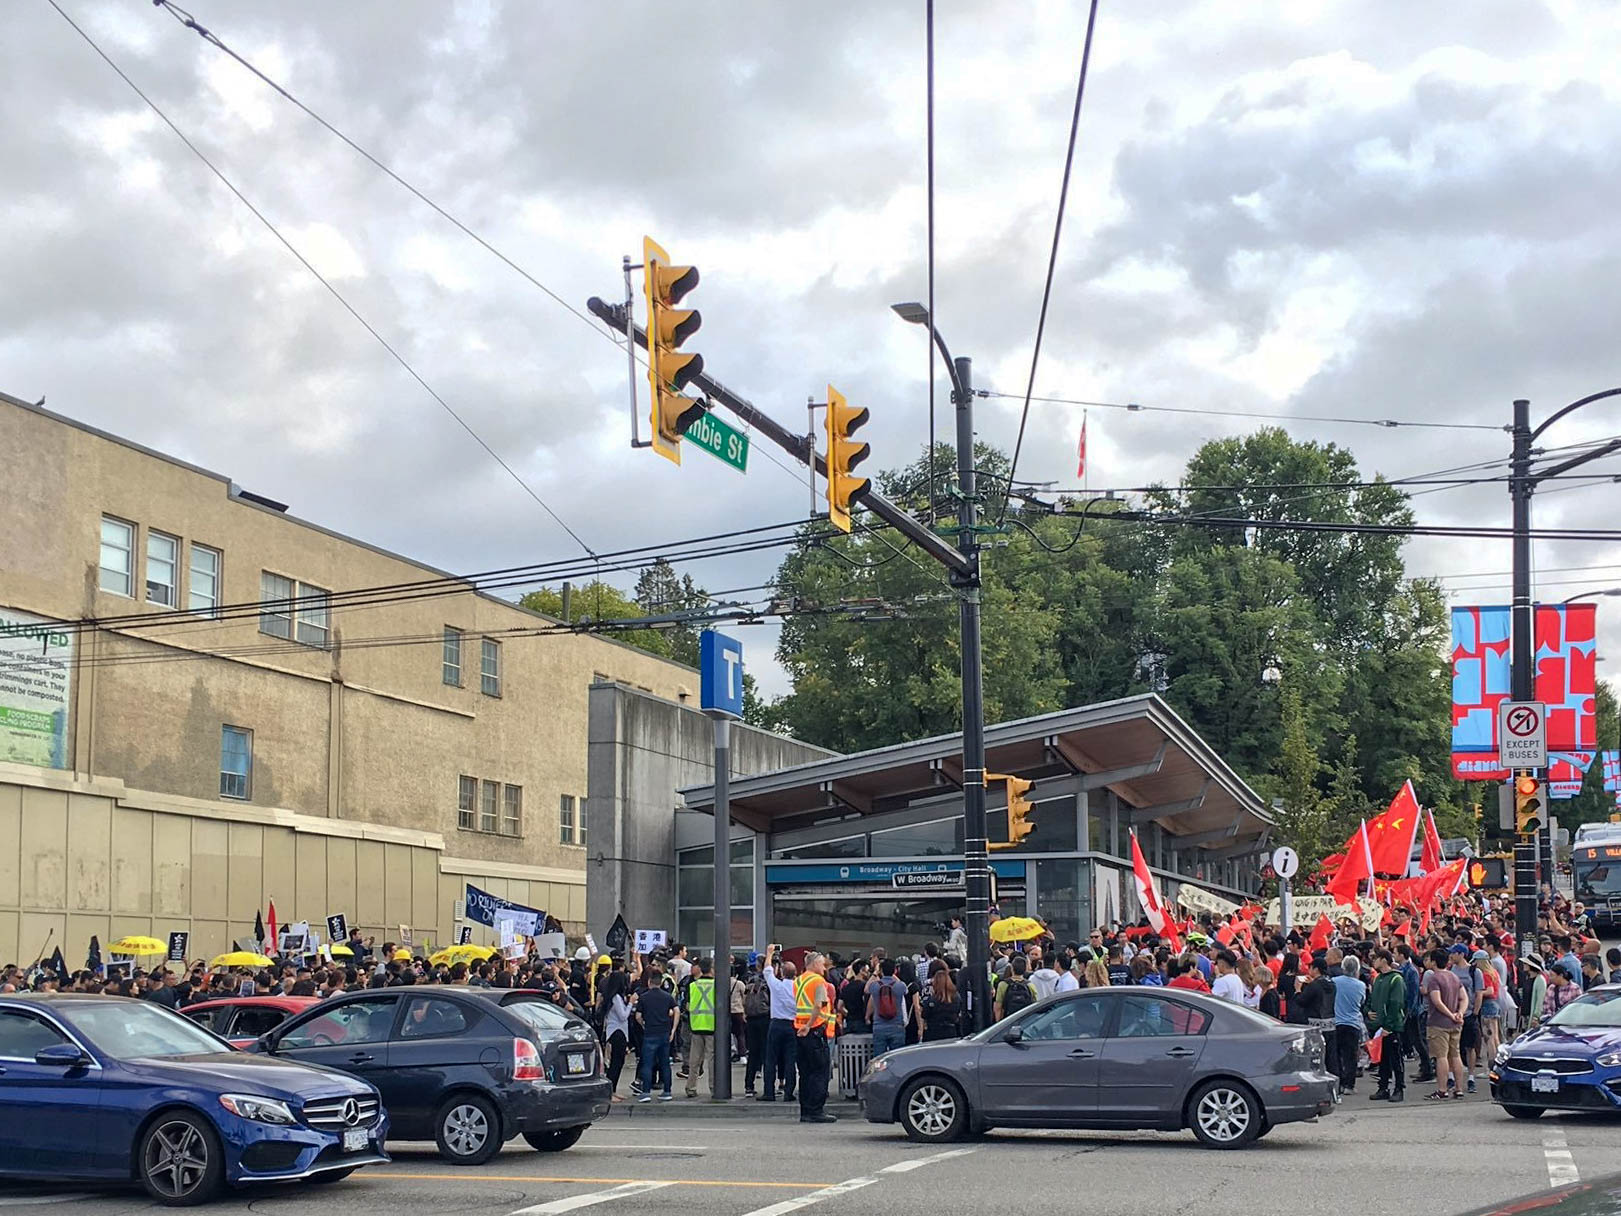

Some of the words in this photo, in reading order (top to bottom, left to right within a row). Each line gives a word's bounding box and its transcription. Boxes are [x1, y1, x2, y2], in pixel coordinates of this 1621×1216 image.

[689, 416, 722, 451] mbie
[728, 433, 743, 463] St
[51, 671, 66, 681] your
[723, 648, 739, 700] T
[1506, 740, 1541, 749] EXCEPT
[1508, 750, 1538, 759] BUSES
[859, 866, 893, 874] Broadway
[898, 865, 912, 873] City
[897, 876, 906, 884] W
[908, 874, 947, 884] Broadway
